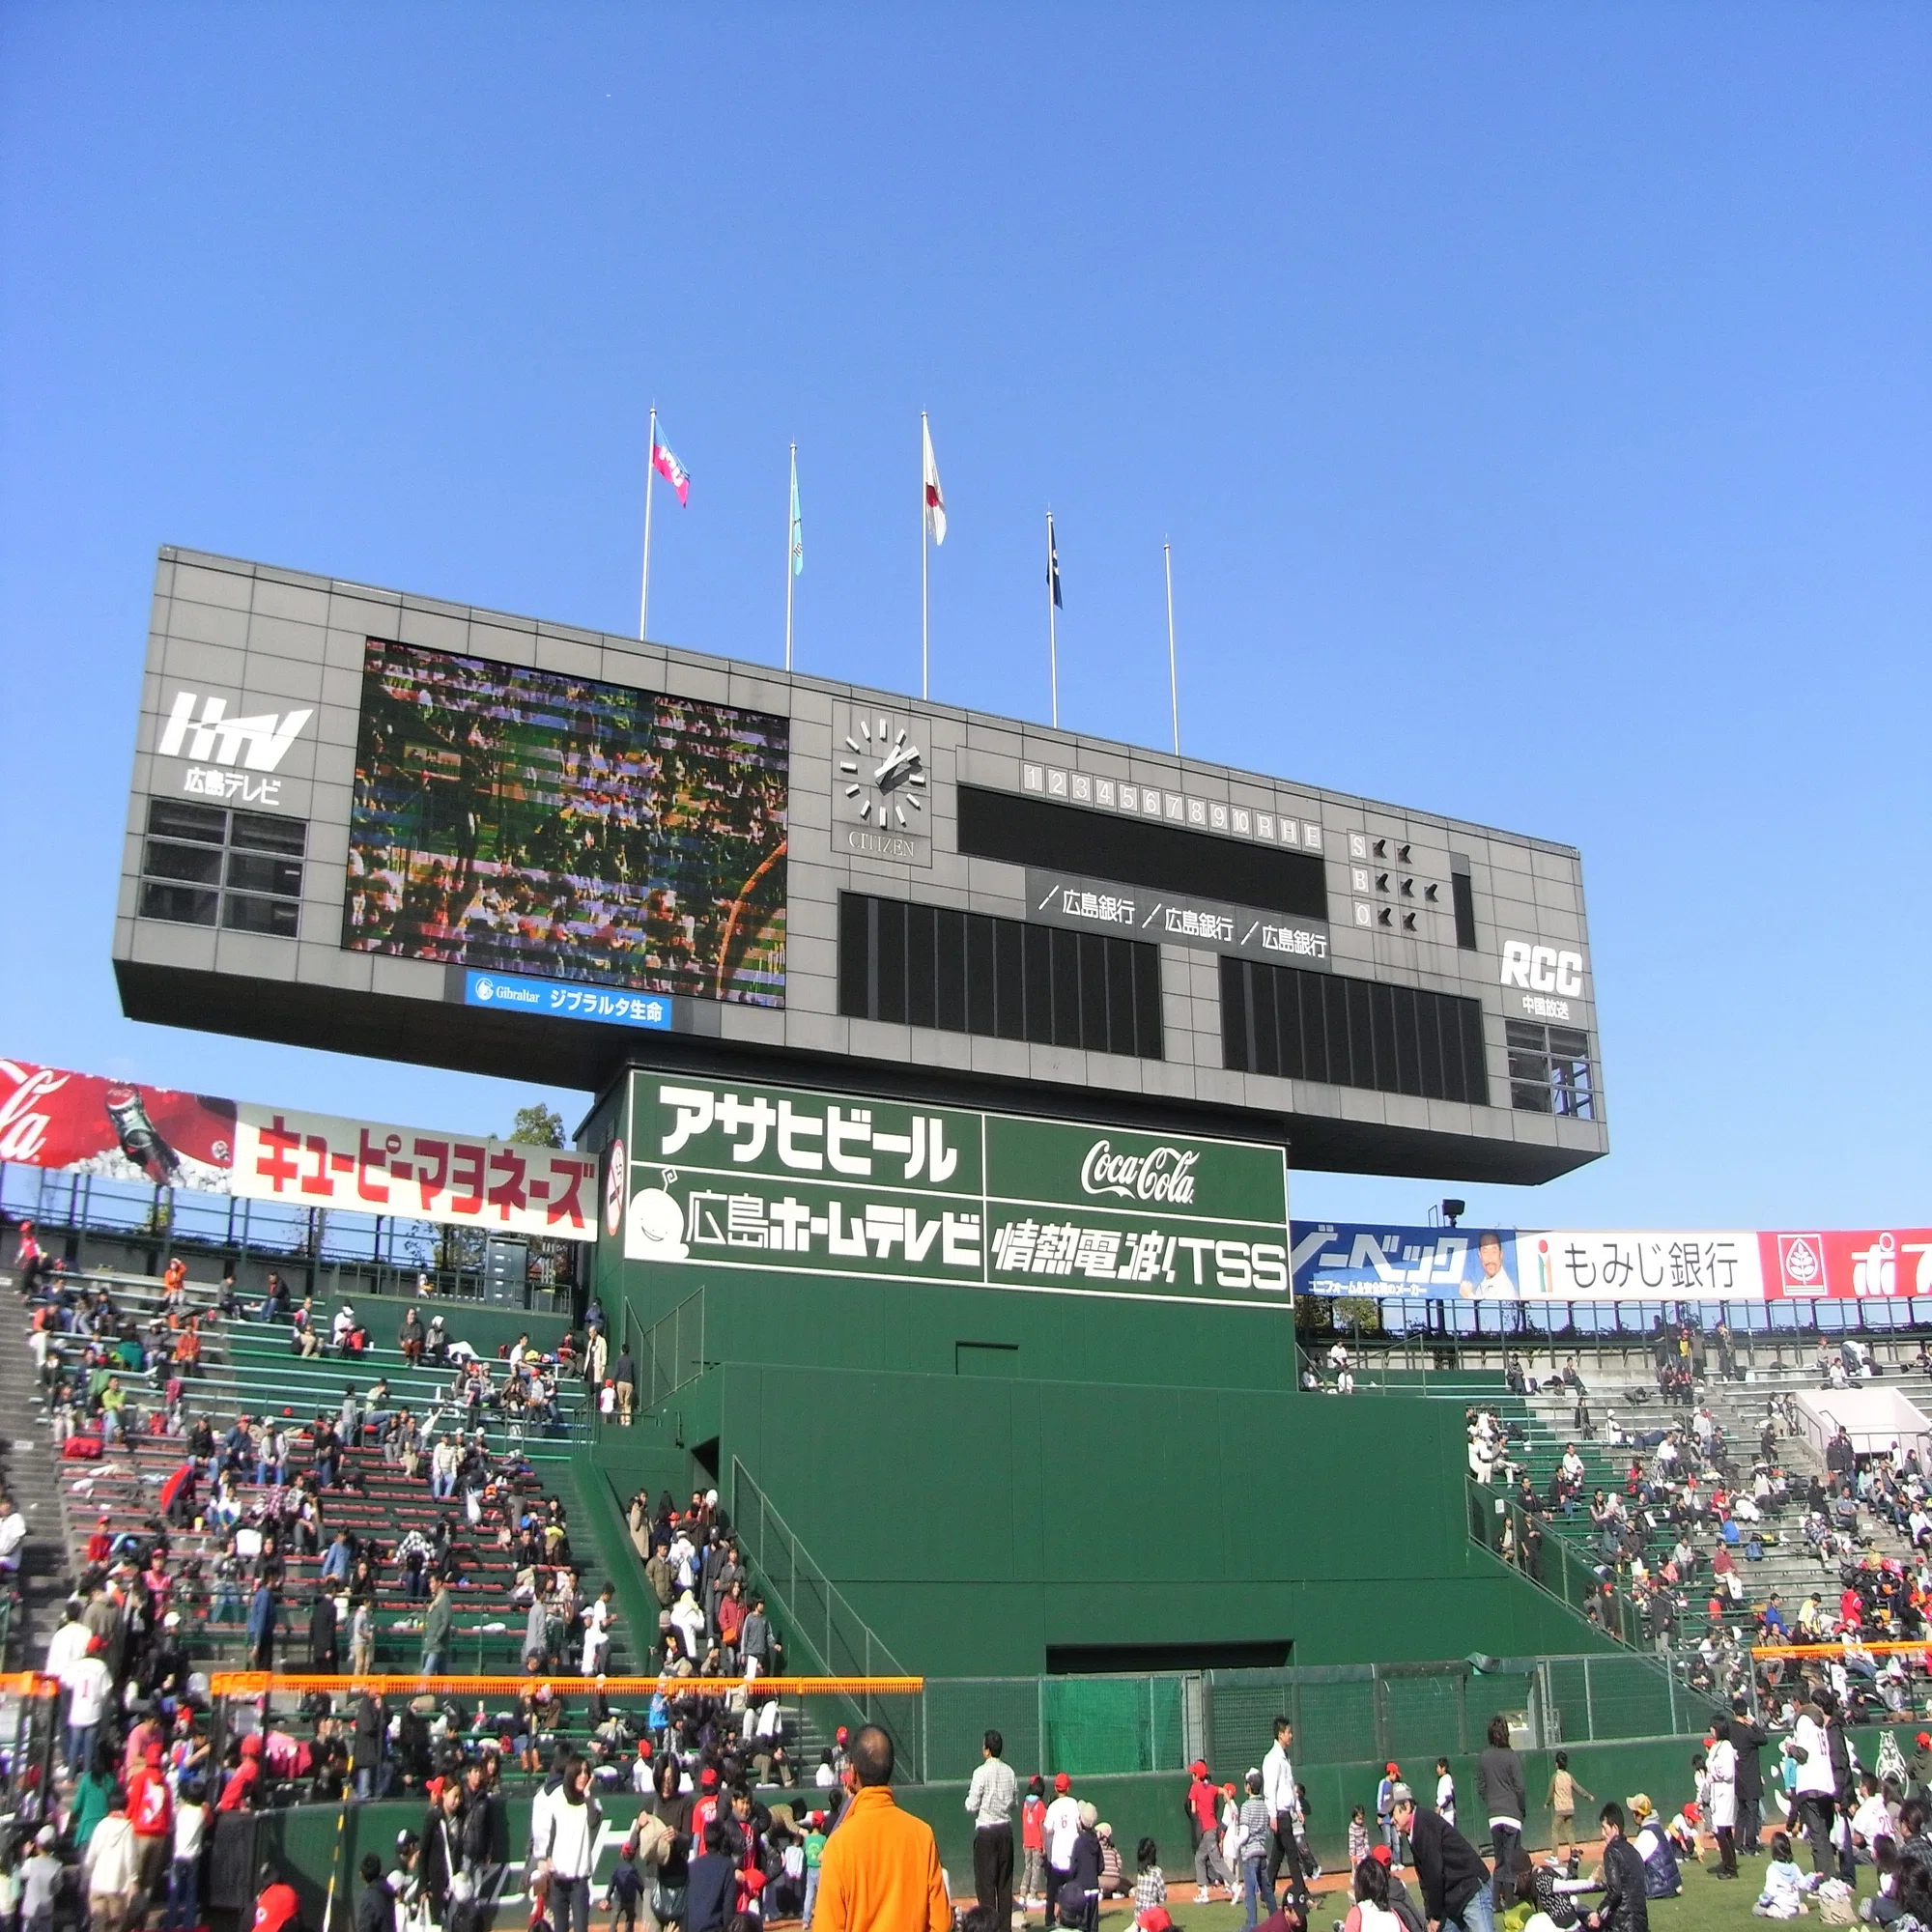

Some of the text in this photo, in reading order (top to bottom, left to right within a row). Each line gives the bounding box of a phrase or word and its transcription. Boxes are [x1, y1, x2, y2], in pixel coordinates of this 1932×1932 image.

[185, 767, 281, 806] 広島テレビ
[1028, 768, 1319, 847] 1 2 3 4 5 6 7 8 9 10 R H E
[849, 831, 914, 858] CITIZEN
[1353, 836, 1363, 856] S
[1355, 869, 1366, 890] B
[1063, 889, 1327, 958] 広島銀行 広島銀行 広島銀行
[1500, 939, 1582, 997] RCC
[496, 985, 664, 1023] Gibraltar ジブラルタ生命
[1522, 995, 1570, 1020] 中国放送
[660, 1085, 957, 1183] アサヒビール
[256, 1114, 595, 1230] キューピーマヨネーズ
[1080, 1139, 1200, 1204] Coca-Cola
[686, 1189, 980, 1266] 広島ホームテレビ
[1564, 1241, 1738, 1289] もみじ銀行
